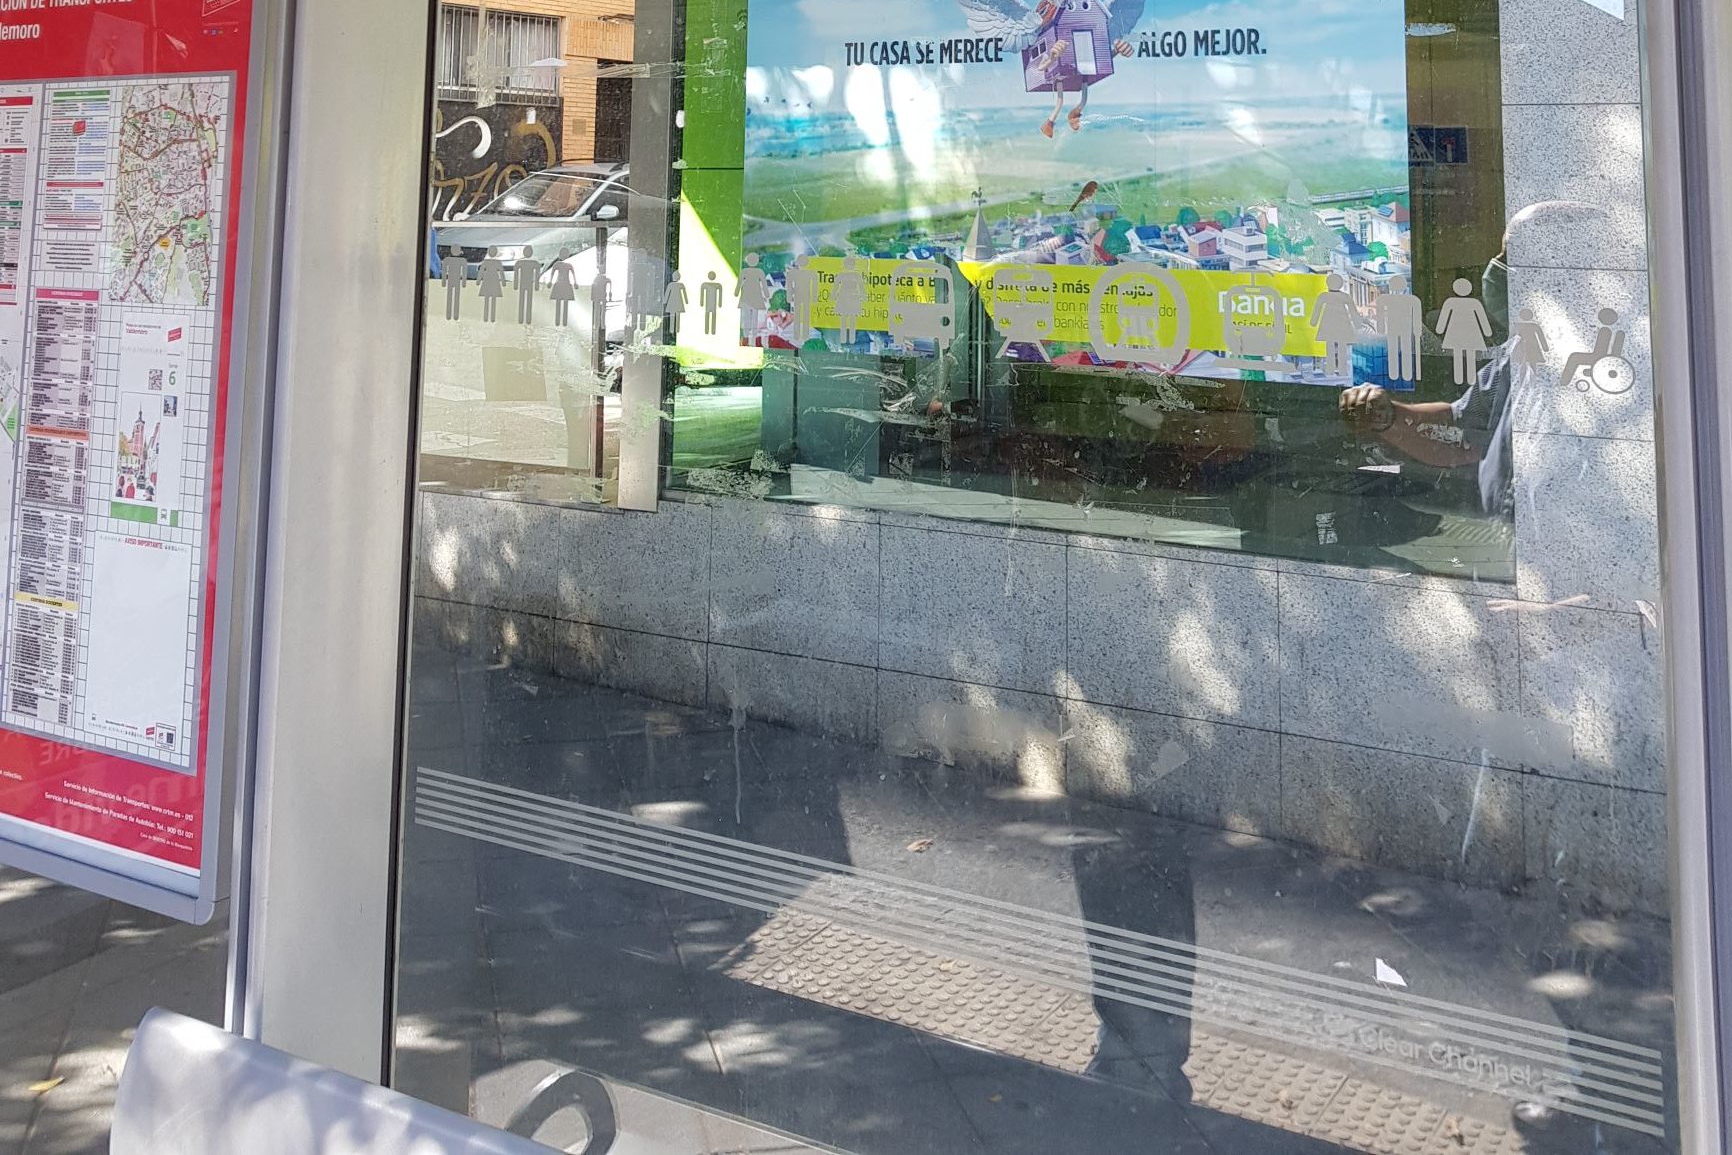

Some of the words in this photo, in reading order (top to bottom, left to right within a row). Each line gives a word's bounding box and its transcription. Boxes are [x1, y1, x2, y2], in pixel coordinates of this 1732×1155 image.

[845, 42, 864, 67] TU
[869, 40, 911, 65] CASA
[915, 41, 934, 64] SE
[939, 37, 1003, 64] MERECE
[1137, 30, 1187, 58] ALGO
[1194, 27, 1267, 56] MEJOR.
[1062, 279, 1090, 294] más
[1056, 301, 1075, 312] con
[168, 371, 176, 385] 6
[1359, 1025, 1423, 1059] Clear
[1428, 1041, 1532, 1086] Channel
